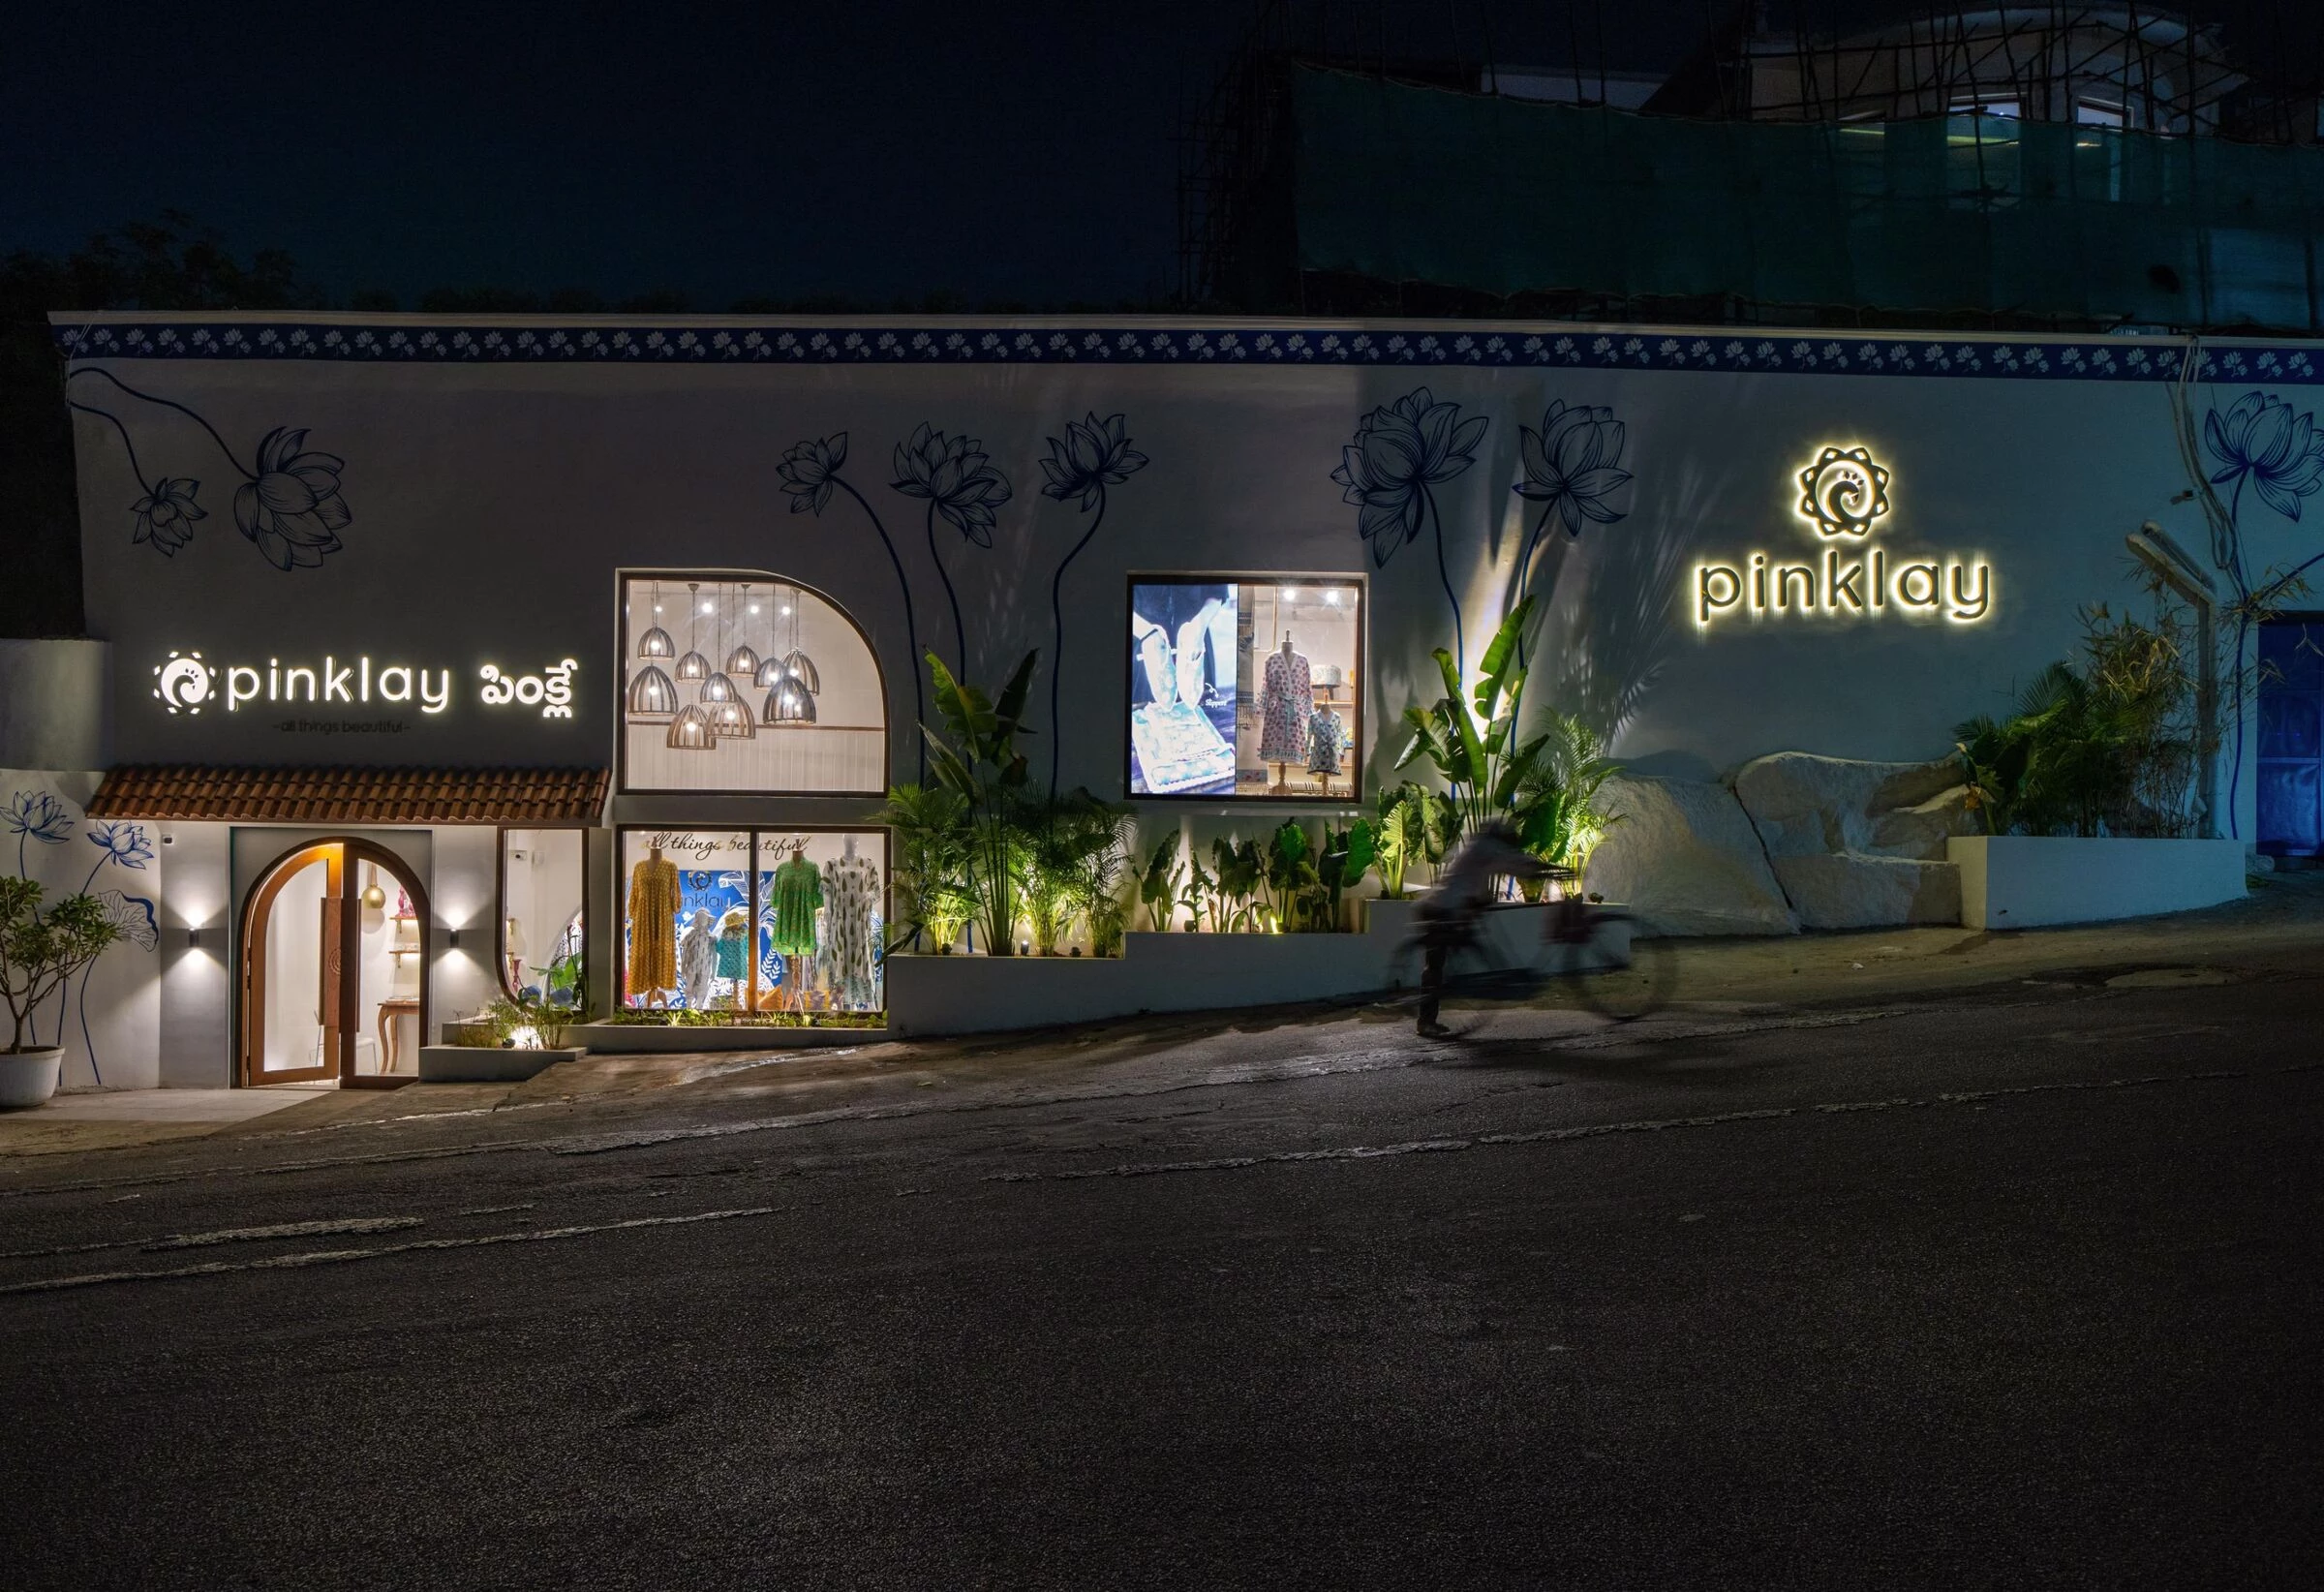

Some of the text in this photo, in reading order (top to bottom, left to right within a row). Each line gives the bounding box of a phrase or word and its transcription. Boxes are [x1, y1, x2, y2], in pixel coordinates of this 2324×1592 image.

[1697, 550, 1989, 622] pinklay
[228, 656, 450, 714] pinklay
[298, 719, 339, 735] things
